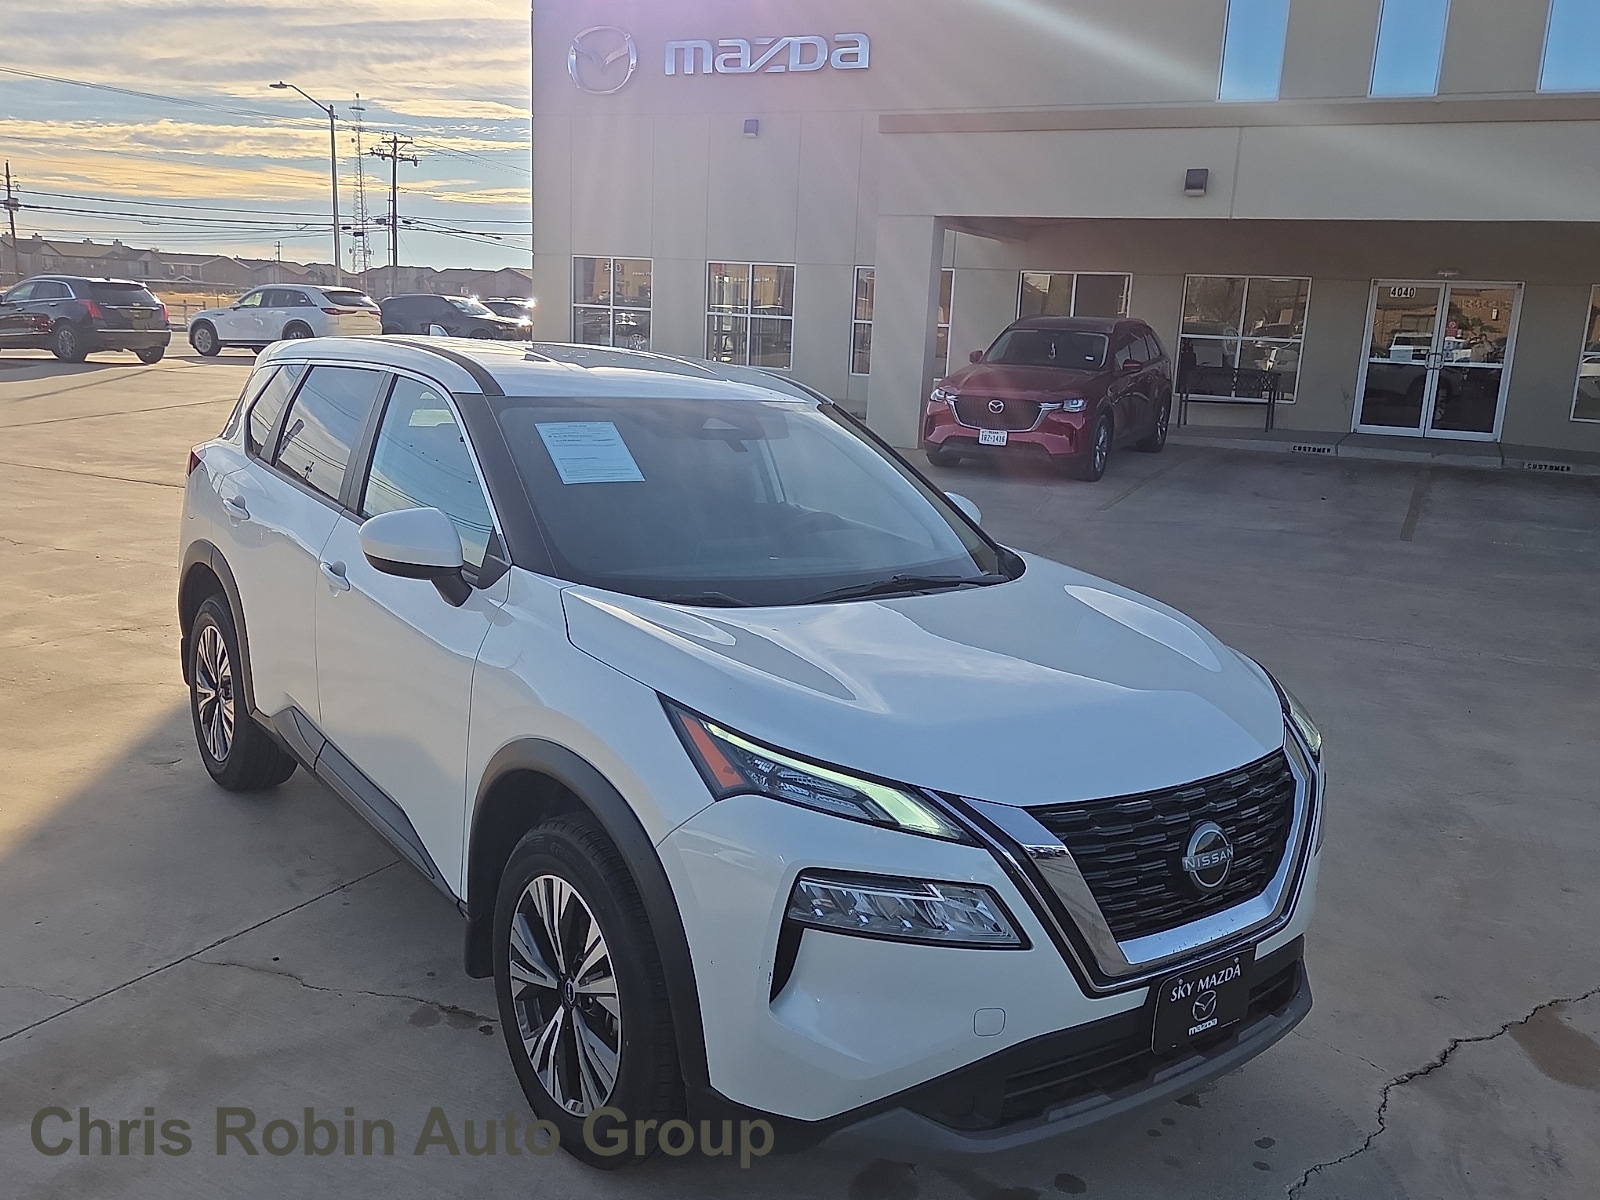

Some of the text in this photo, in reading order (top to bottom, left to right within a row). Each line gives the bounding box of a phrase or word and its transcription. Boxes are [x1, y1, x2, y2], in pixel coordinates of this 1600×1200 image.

[1391, 287, 1416, 298] 4040
[1292, 445, 1332, 453] CUSTOMER
[1527, 463, 1571, 471] CUSTOMER
[1184, 848, 1233, 869] NISSAN
[1170, 963, 1241, 1002] SKY MAZDA
